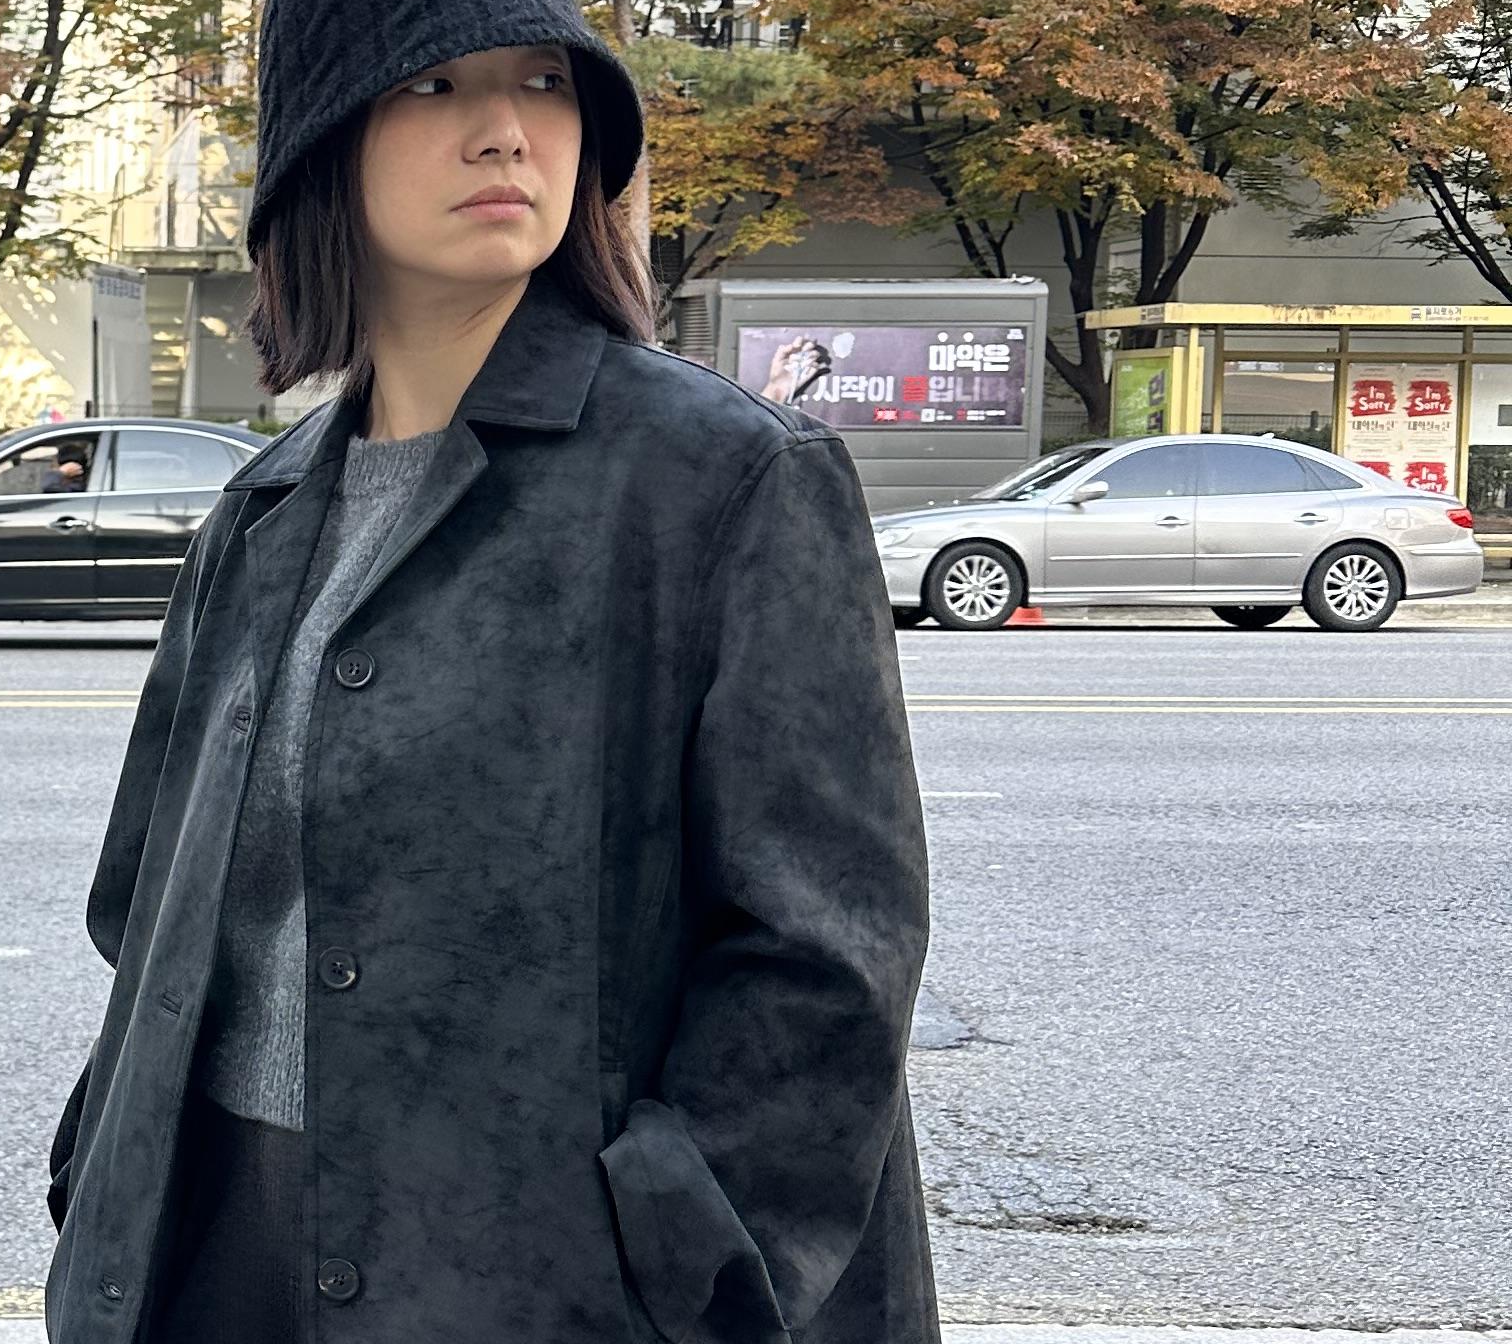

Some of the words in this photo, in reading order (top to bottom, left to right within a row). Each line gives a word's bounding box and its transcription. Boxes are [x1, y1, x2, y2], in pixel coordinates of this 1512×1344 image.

[929, 344, 1010, 372] 마약은
[813, 375, 894, 403] 시작이
[1358, 397, 1390, 411] Sorry
[1414, 397, 1446, 412] Sorry
